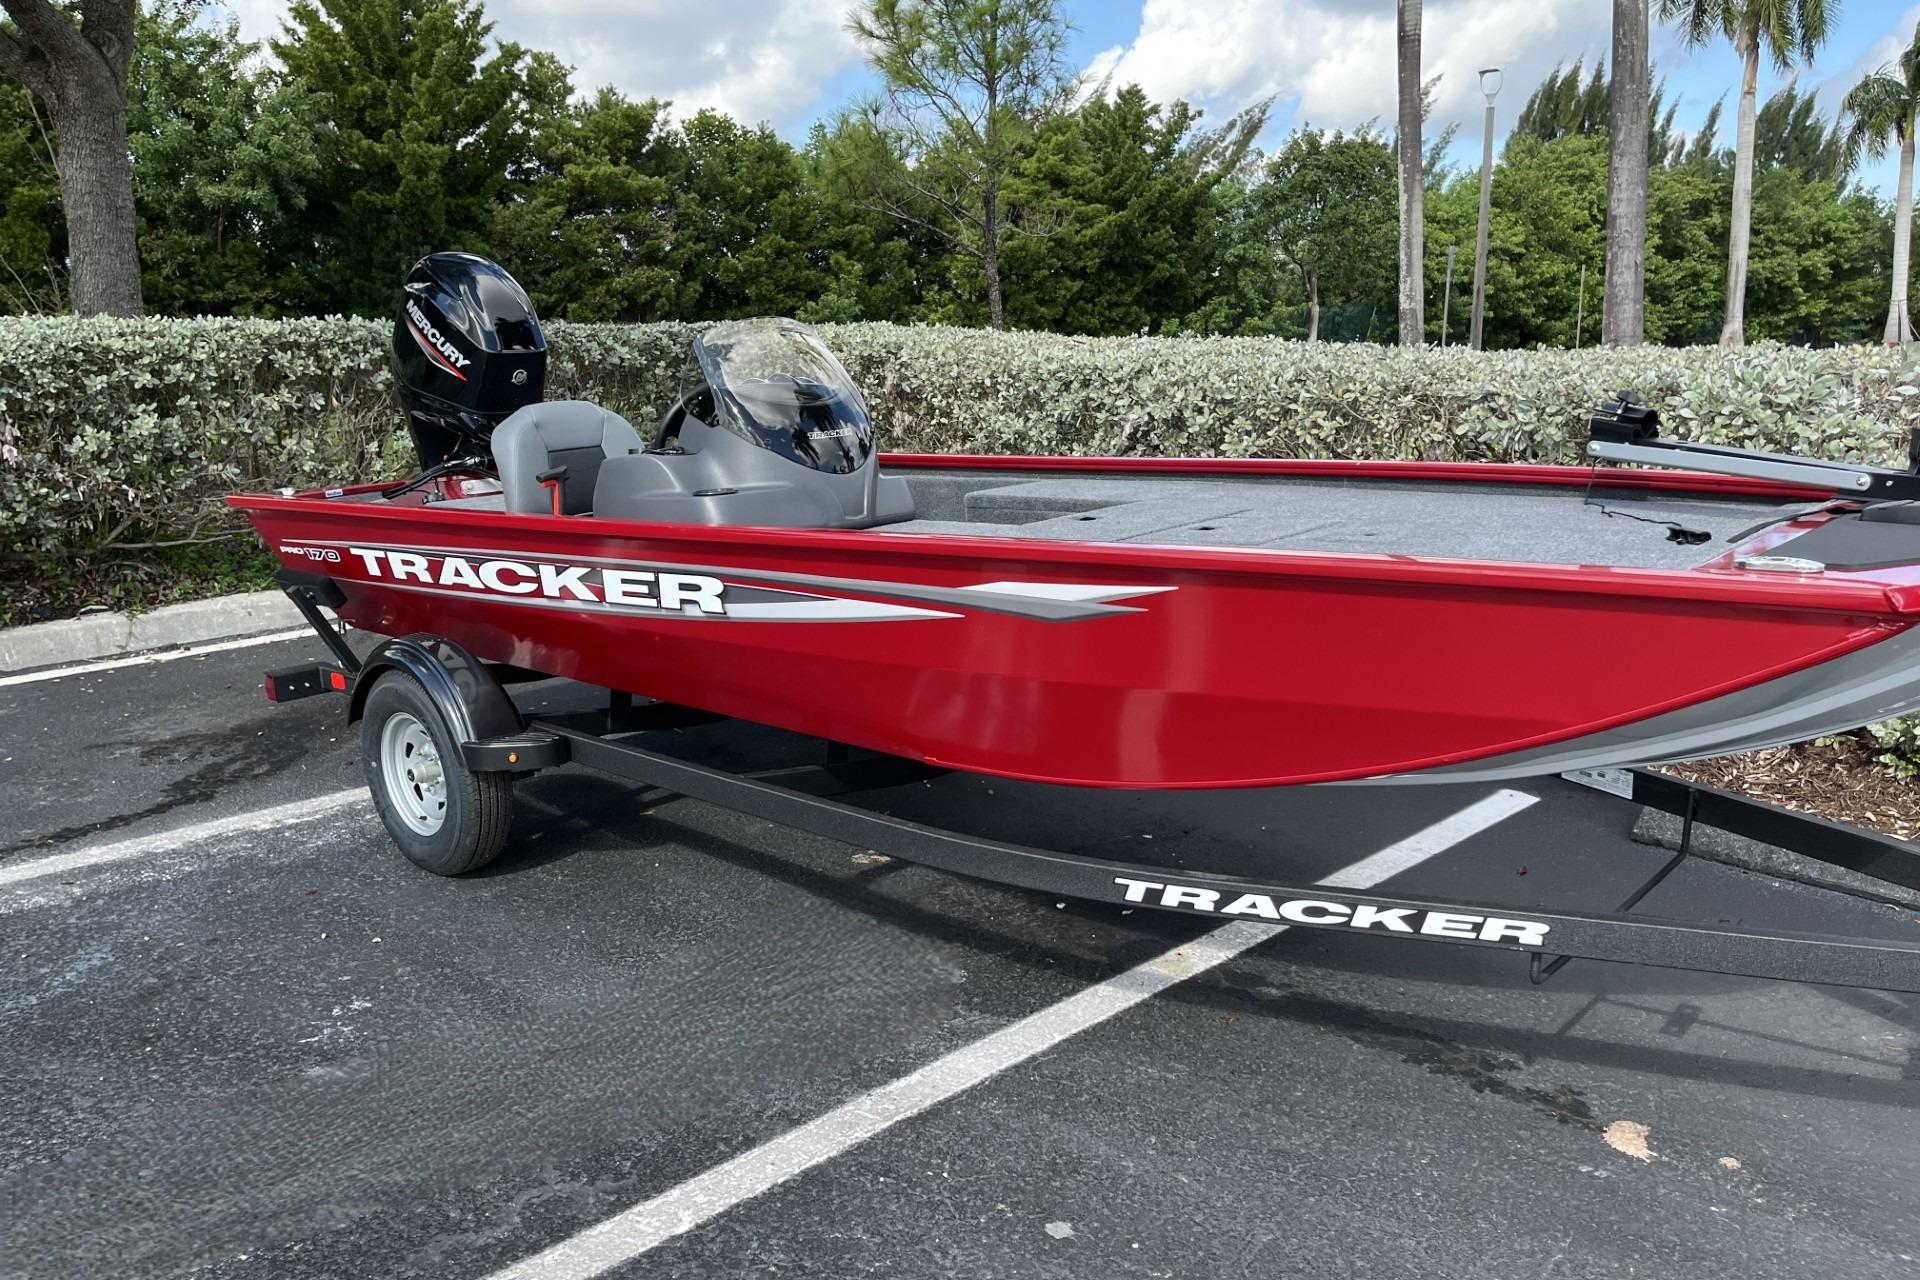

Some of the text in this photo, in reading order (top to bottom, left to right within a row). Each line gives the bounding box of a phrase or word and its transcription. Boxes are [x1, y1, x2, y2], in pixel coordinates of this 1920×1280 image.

[405, 299, 472, 368] MERCURY
[280, 546, 341, 562] PRO 170
[349, 547, 726, 615] TRACKER
[1113, 876, 1551, 946] TRACKER
